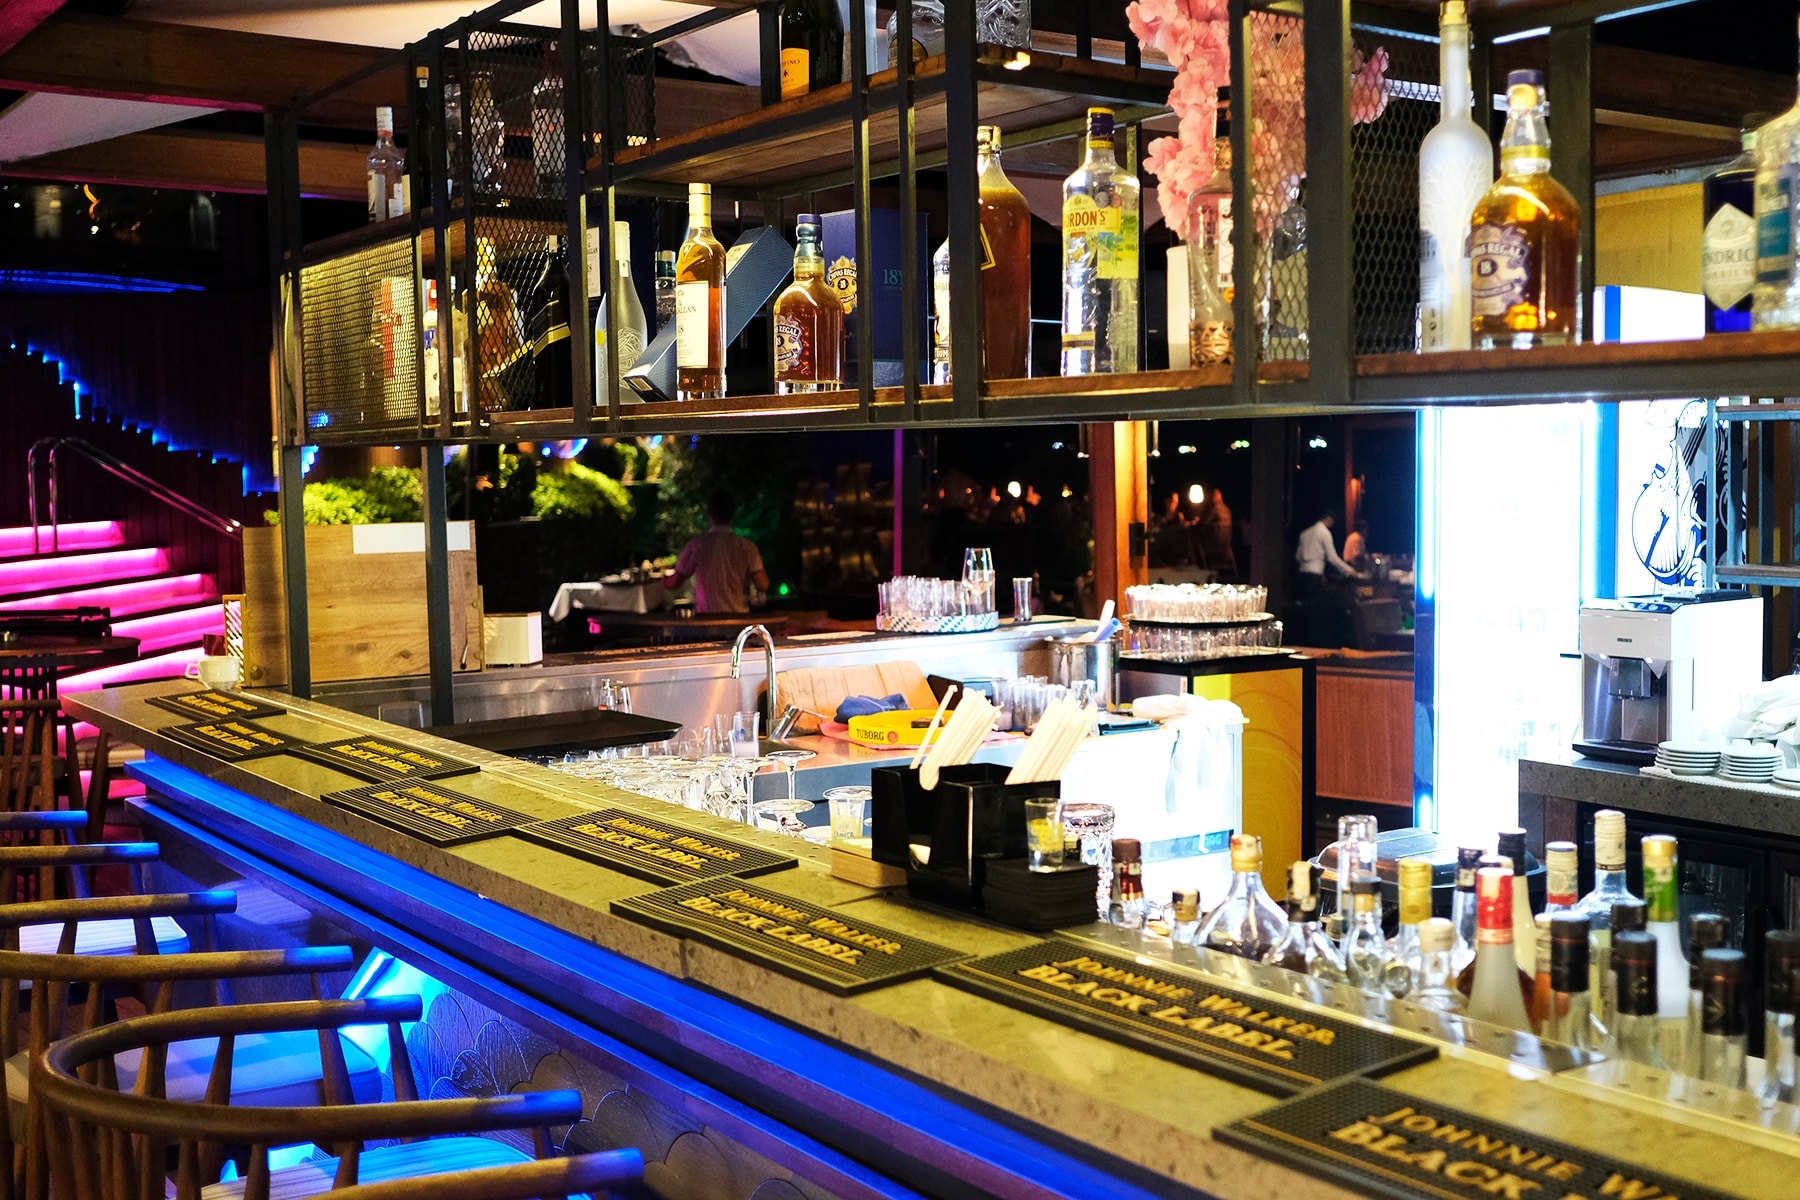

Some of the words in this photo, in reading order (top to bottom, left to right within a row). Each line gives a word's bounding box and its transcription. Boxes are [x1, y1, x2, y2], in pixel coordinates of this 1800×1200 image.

[779, 324, 801, 337] REGAL
[856, 728, 885, 741] TUBORG
[367, 756, 417, 774] LABEL
[368, 790, 429, 812] BLACK
[414, 807, 473, 830] LABEL
[449, 801, 503, 823] WALKER
[569, 822, 646, 849] BLACK
[632, 842, 709, 870] LABEL
[596, 817, 675, 840] JOHNNIE
[671, 836, 742, 862] WALKER
[677, 895, 777, 930] BLACK
[762, 924, 864, 966] LABEL
[708, 889, 811, 922] JOHNNIE
[807, 917, 902, 955] WALKER
[1018, 963, 1158, 1013] BLACK
[1149, 1005, 1294, 1060] LABEL
[1052, 955, 1195, 1000] JOHNNIE
[1198, 993, 1336, 1046] WALKER
[1329, 1118, 1544, 1200] BLACK
[1368, 1106, 1585, 1181] JOHNNIE
